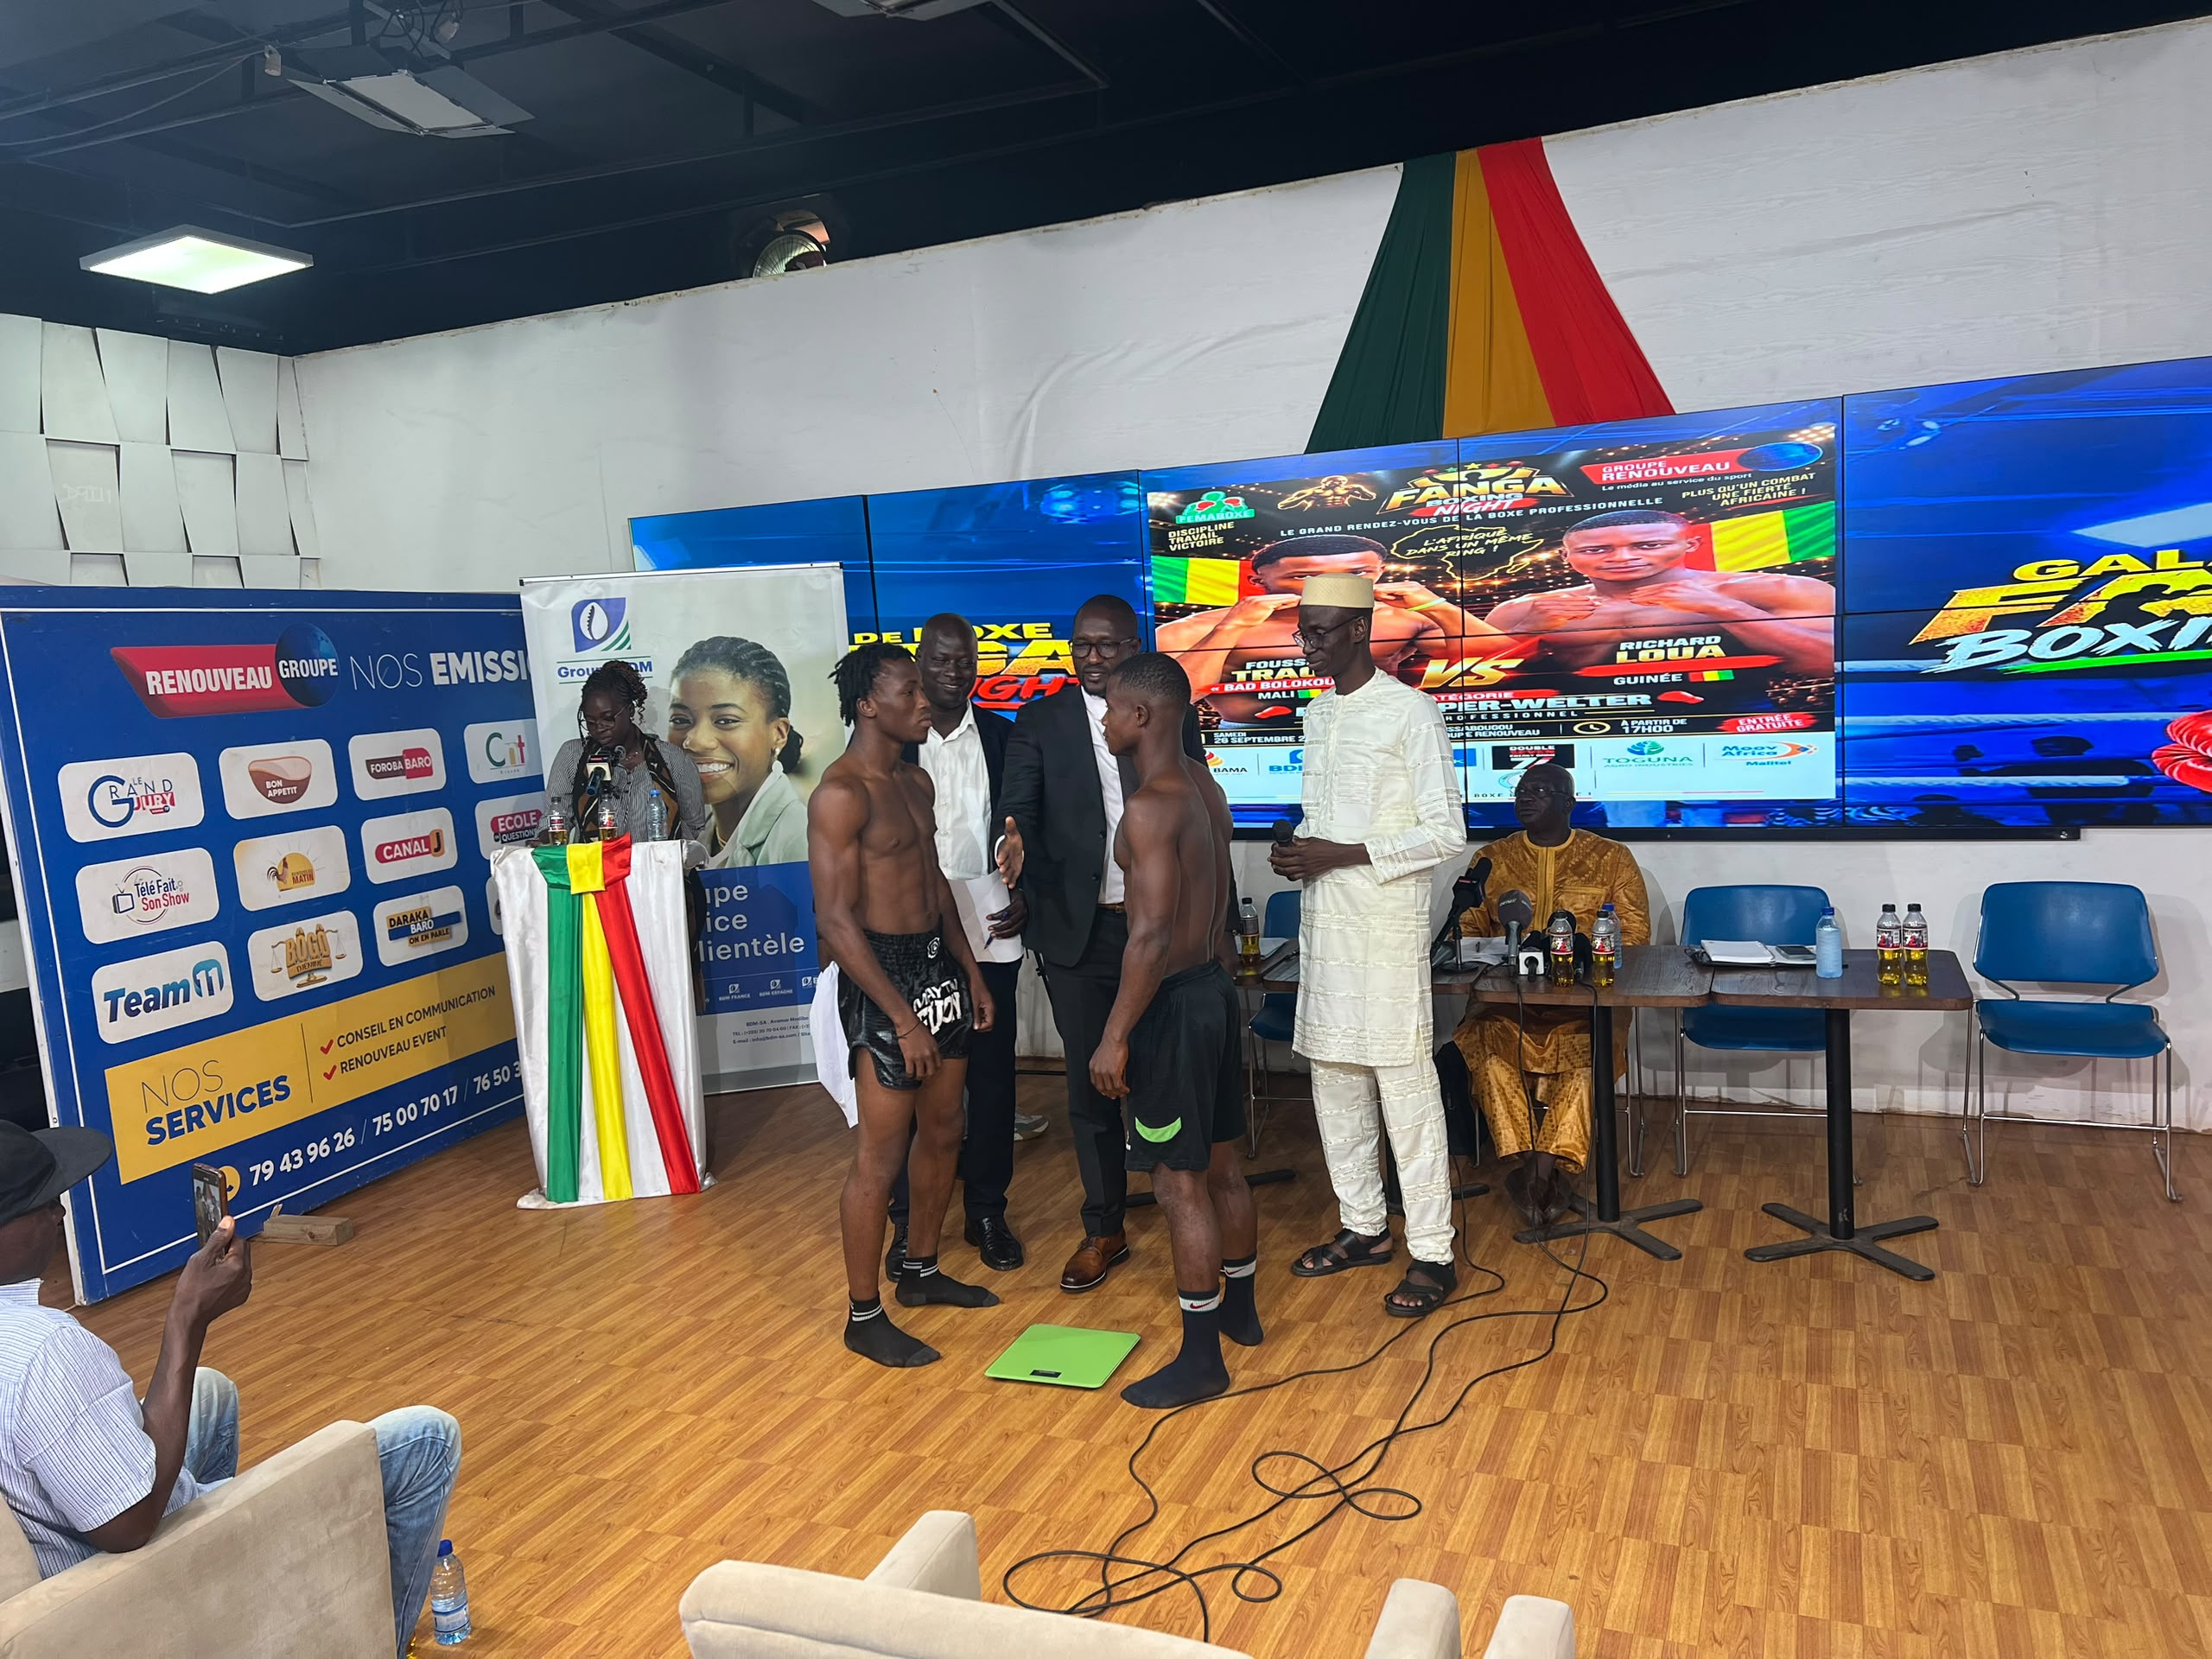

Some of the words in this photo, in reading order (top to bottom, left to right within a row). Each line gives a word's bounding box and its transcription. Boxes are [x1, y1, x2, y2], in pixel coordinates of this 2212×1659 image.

[1601, 461, 1730, 481] RENOUVEAU
[1602, 461, 1666, 473] GROUPE
[1667, 476, 1705, 486] service
[1724, 473, 1752, 481] sport
[1681, 488, 1713, 499] PLUS
[1718, 481, 1758, 493] QU'UN
[1761, 473, 1816, 486] COMBAT
[1385, 477, 1568, 510] FANGA
[1426, 493, 1523, 507] BOXING
[1712, 491, 1739, 501] UNE
[1719, 488, 1797, 506] AFRICAINE
[1179, 509, 1253, 524] FEMABOXE
[1299, 524, 1341, 535] GRAND
[1347, 518, 1438, 531] RENDEZ-VOUS
[1488, 510, 1523, 519] BOXE
[1529, 497, 1663, 516] PROFESSIONNELLE
[1433, 499, 1519, 516] NIGHT
[1168, 522, 1235, 538] DISCIPLINE
[1169, 531, 1218, 544] TRAVAIL
[1424, 529, 1508, 547] L'AFRIQUE
[1169, 537, 1224, 551] VICTOIRE
[1406, 545, 1448, 556] DANS
[1455, 540, 1480, 550] UN
[1484, 532, 1534, 545] MÊME
[1445, 547, 1486, 557] RING
[2013, 549, 2212, 582] GAL
[854, 632, 901, 645] DE
[1619, 636, 1722, 651] RICHARD
[1920, 616, 2212, 675] BOXI
[1616, 645, 1726, 664] LOUA
[349, 653, 423, 690] NOS
[429, 650, 530, 685] EMISSI
[557, 665, 602, 678] Grou
[1245, 658, 1310, 670] FOUSS
[1420, 657, 1526, 689] VS
[145, 666, 273, 695] RENOUVEAU
[278, 658, 338, 678] GROUPE
[1224, 683, 1256, 692] BAD
[1260, 677, 1336, 690] BOLOKOU
[1613, 673, 1683, 685] GUINÉE
[1258, 690, 1294, 700] MALI
[1437, 694, 1652, 713] PER-WELTER
[1446, 710, 1578, 721] ROFESSIONNEL
[1738, 714, 1791, 726] ENTRÉE
[1622, 725, 1674, 734] 17H00
[1736, 719, 1803, 733] GRATUITE
[370, 760, 404, 774] FOROBA
[404, 756, 432, 770] BARO
[132, 777, 143, 785] LE
[265, 779, 283, 789] BON
[134, 791, 175, 811] JURY
[267, 786, 297, 798] APPETIT
[498, 812, 537, 832] ECOLE
[382, 839, 429, 860] CANAL
[433, 831, 441, 853] J
[292, 872, 314, 885] MATIN
[134, 880, 156, 898] Télé
[156, 878, 176, 893] Fait
[142, 896, 162, 912] Son
[162, 892, 190, 907] Show
[389, 910, 429, 928] DARAKA
[410, 918, 434, 934] BARO
[706, 912, 747, 933] ice
[409, 936, 419, 944] ON
[430, 927, 450, 939] PARLE
[698, 931, 805, 963] lientèle
[103, 978, 190, 1023] Team
[337, 1022, 387, 1048] CONSEIL
[389, 1015, 404, 1031] EN
[405, 985, 496, 1025] COMMUNICATION
[340, 1037, 410, 1074] RENOUVEAU
[413, 1026, 447, 1048] EVENT
[142, 1060, 223, 1113] NOS
[146, 1075, 291, 1145] SERVICES
[250, 1160, 275, 1187] 79
[279, 1148, 303, 1173] 43
[306, 1139, 331, 1164] 96
[333, 1128, 355, 1154] 26
[372, 1113, 393, 1137] 75
[396, 1103, 418, 1124] 00
[420, 1093, 441, 1116] 70
[442, 1085, 458, 1107] 17
[473, 1073, 491, 1095] 76
[493, 1065, 511, 1087] 50
[512, 1060, 522, 1078] 3
